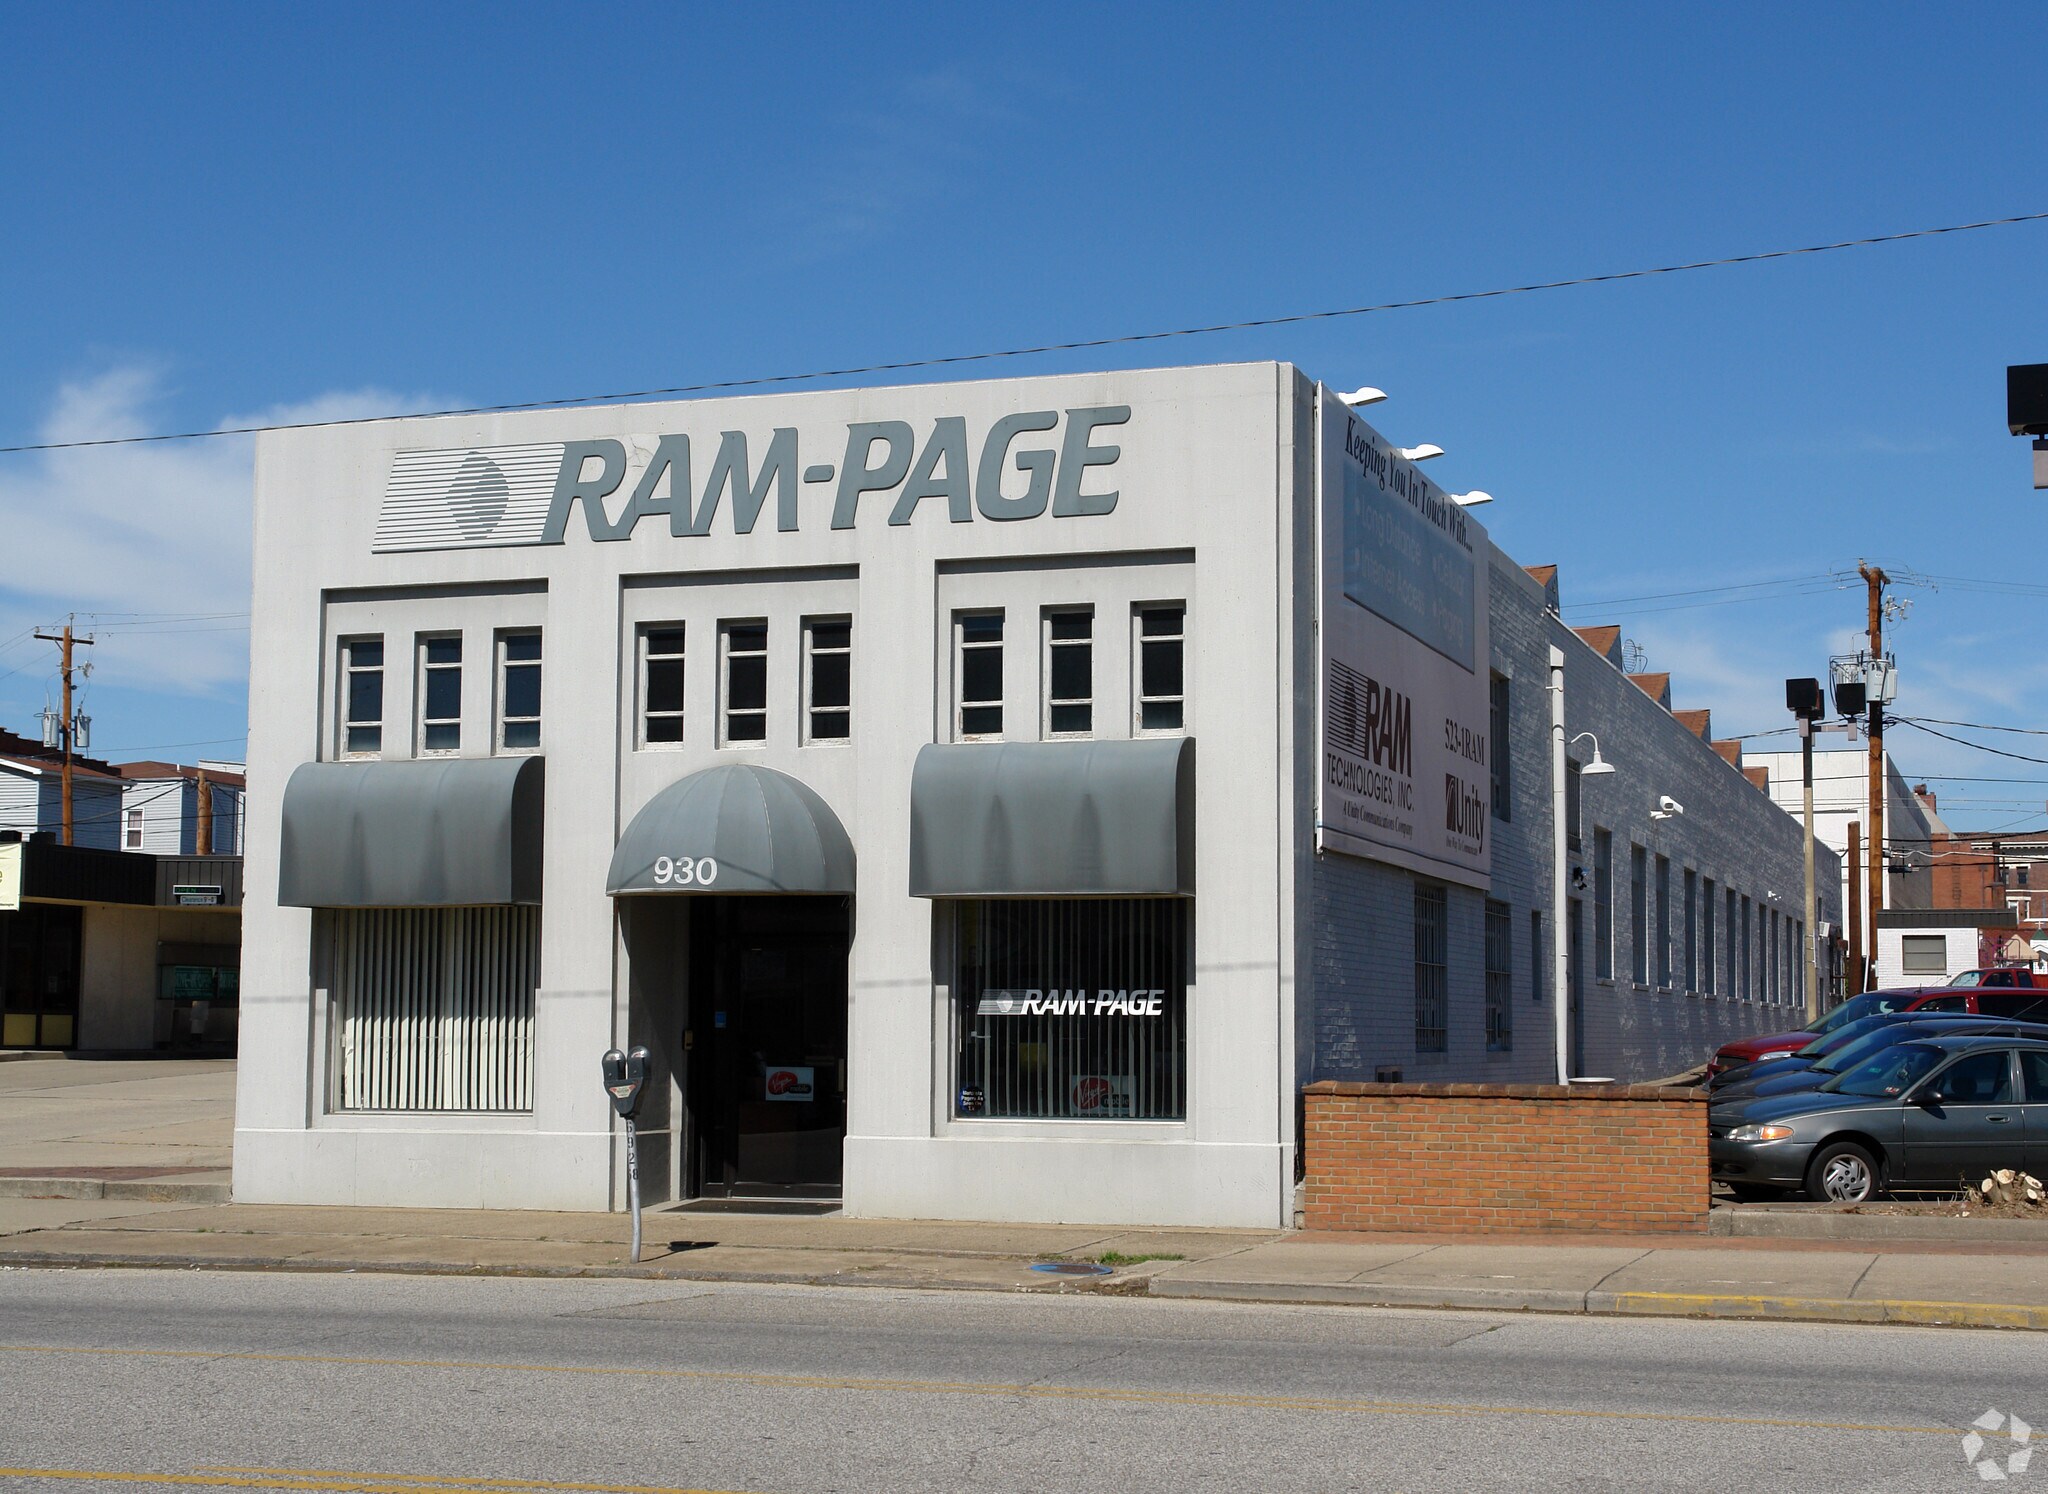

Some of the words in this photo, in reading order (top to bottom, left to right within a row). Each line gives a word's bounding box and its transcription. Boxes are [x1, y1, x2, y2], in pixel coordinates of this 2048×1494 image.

[540, 405, 1131, 546] RAM-PAGE
[1344, 415, 1387, 491] Keeping
[1389, 451, 1406, 499] You
[1408, 468, 1418, 507] In
[1421, 480, 1447, 531] Touch
[1365, 678, 1412, 778] RAM
[1445, 718, 1485, 766] 523-1RAM
[1327, 752, 1395, 810] TECHNOLOGIES,
[1398, 780, 1415, 812] INC.
[1456, 776, 1485, 855] Unity
[653, 856, 718, 885] 930
[1020, 989, 1165, 1016] RAM-PAGE
